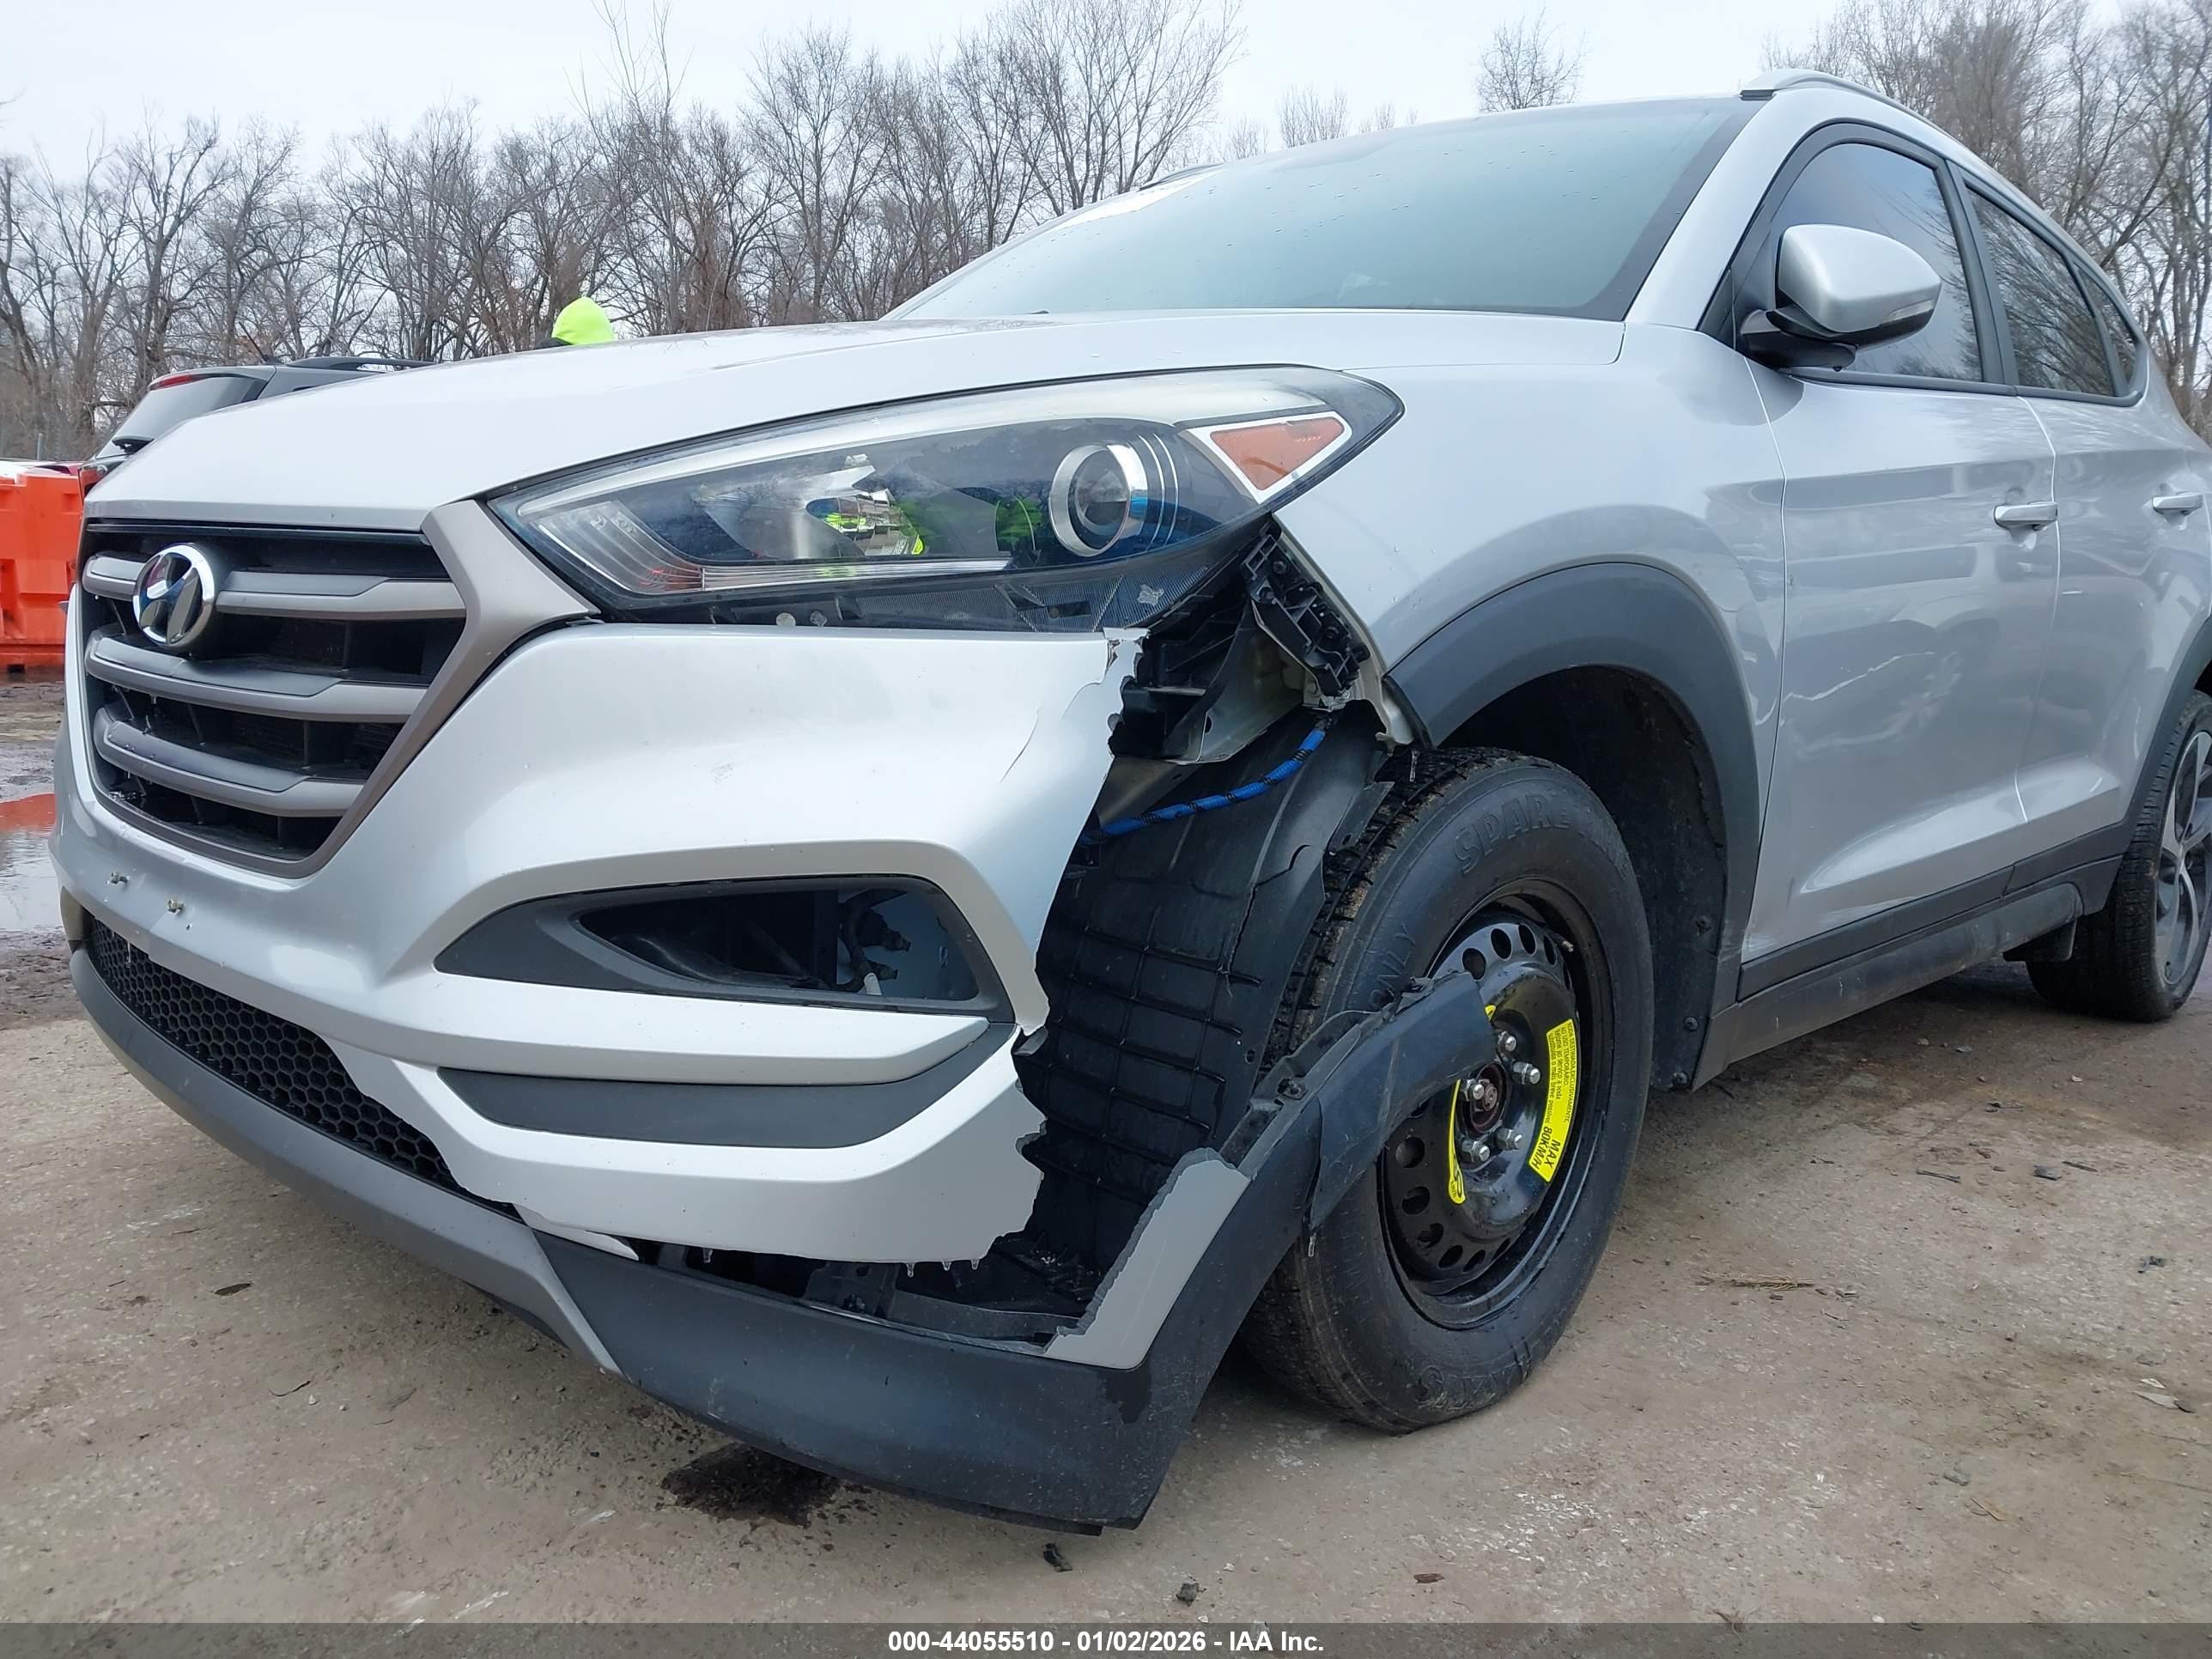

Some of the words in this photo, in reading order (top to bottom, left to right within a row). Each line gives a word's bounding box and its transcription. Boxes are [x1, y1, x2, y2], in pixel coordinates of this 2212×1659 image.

[1455, 793, 1570, 876] SPARE
[1531, 1126, 1553, 1170] 80KM/H
[1544, 1139, 1561, 1169] MAX
